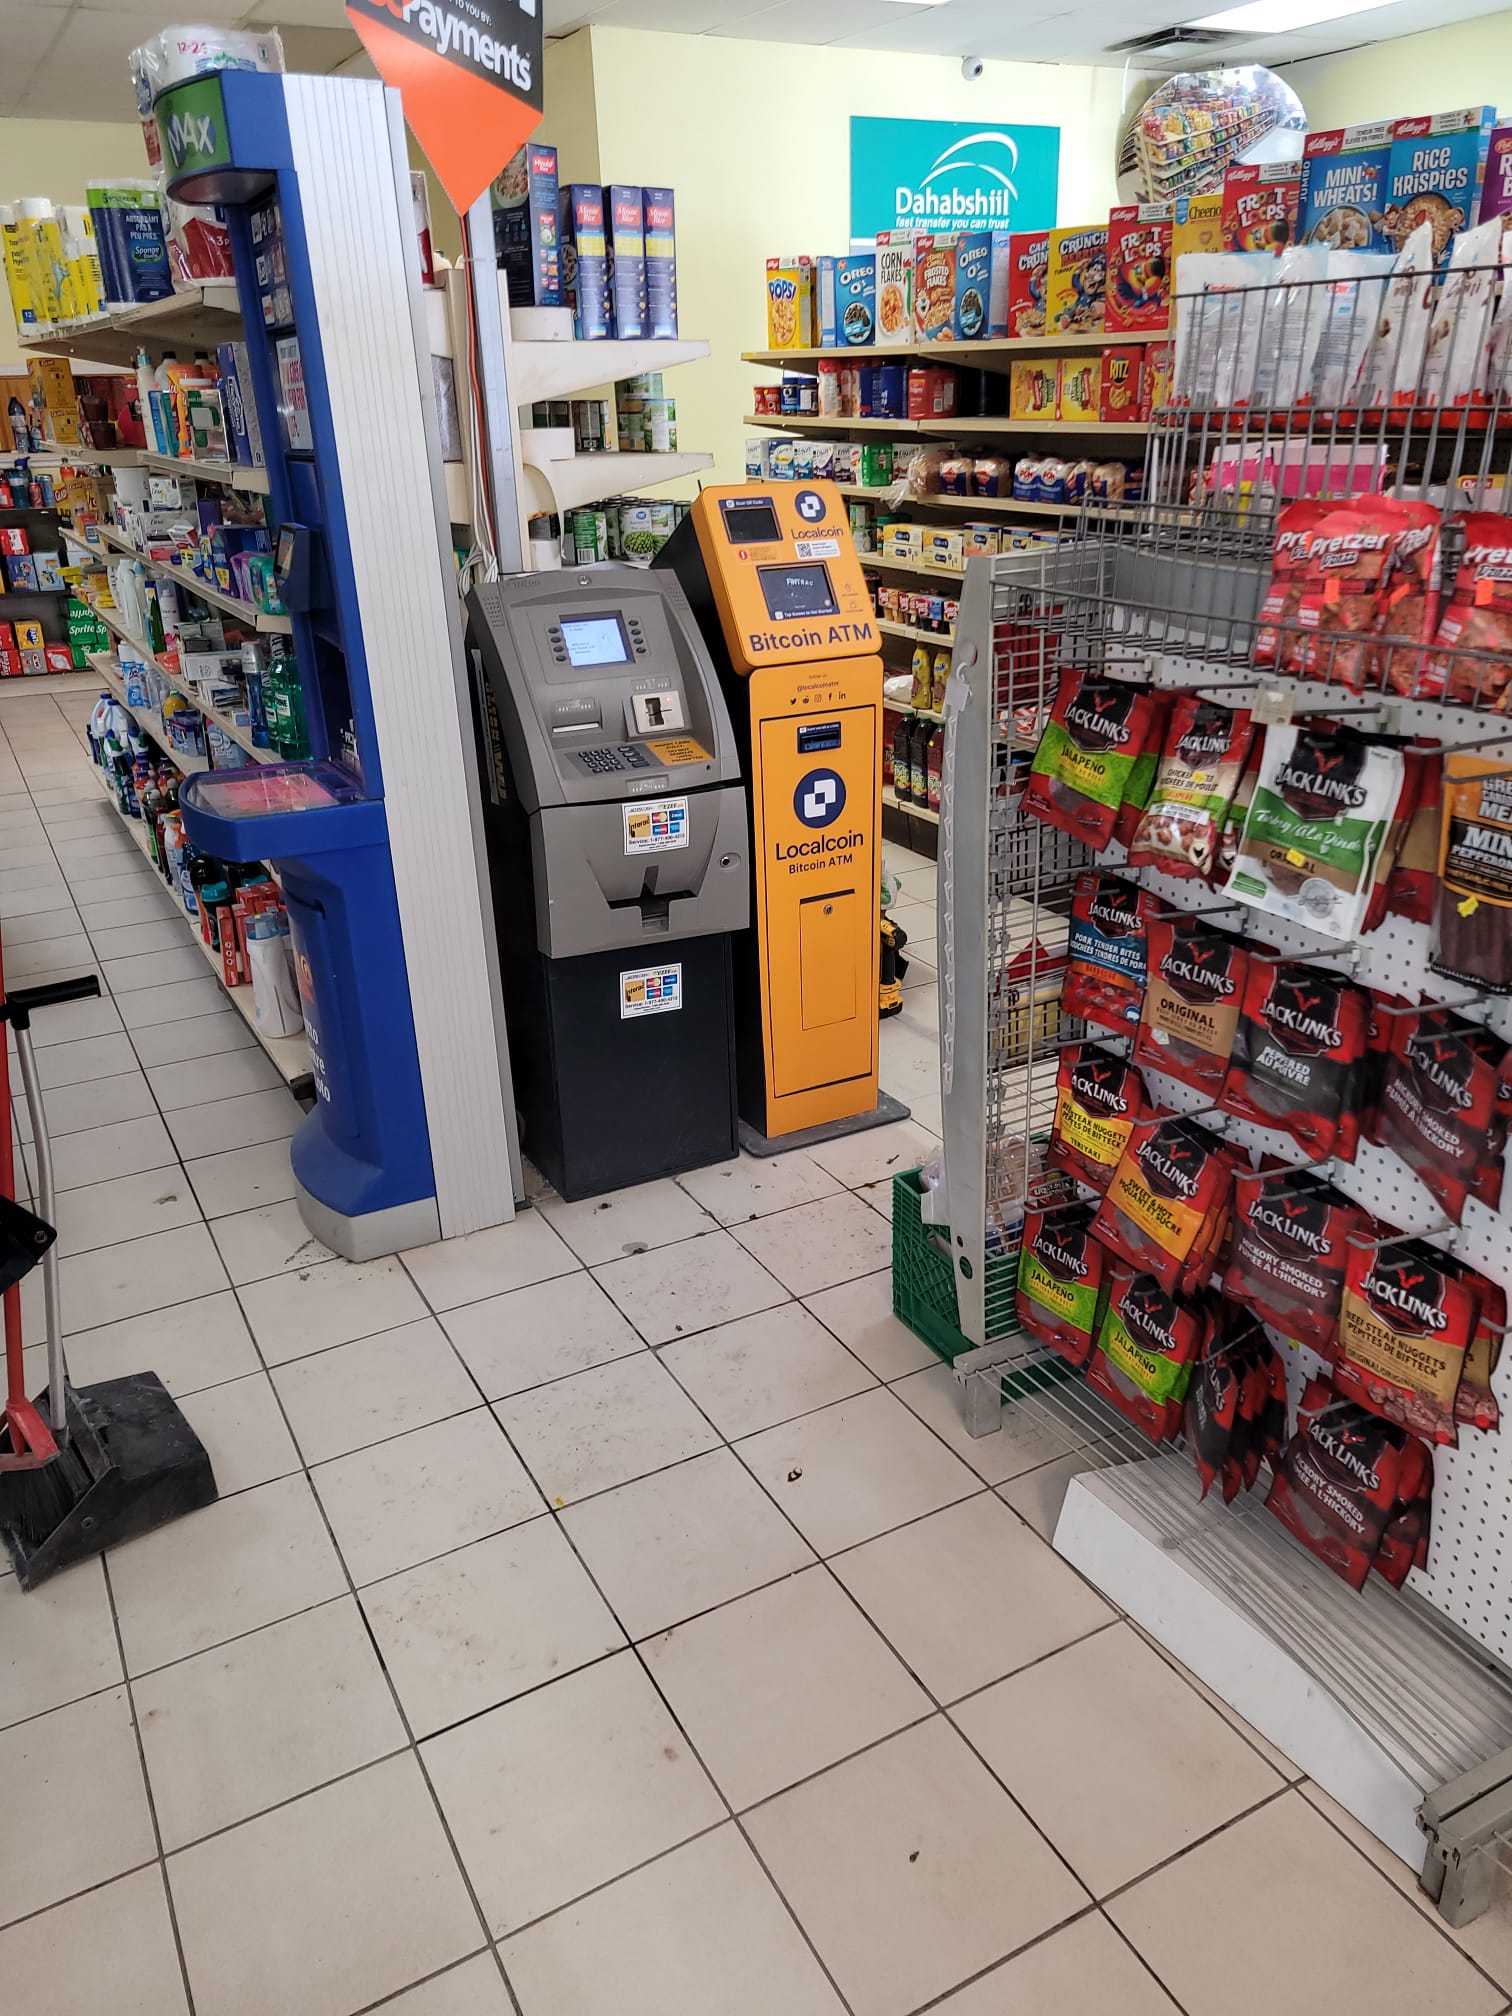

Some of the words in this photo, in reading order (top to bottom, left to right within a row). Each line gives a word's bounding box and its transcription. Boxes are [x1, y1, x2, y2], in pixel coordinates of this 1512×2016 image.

[465, 3, 480, 20] YOU
[168, 112, 214, 167] MAX
[1299, 160, 1312, 203] JUMBO
[1325, 166, 1363, 189] MINI
[895, 187, 1009, 216] Dahabshiil
[1313, 183, 1378, 209] WHEATS!
[895, 217, 913, 230] fast
[914, 217, 951, 230] transfer
[951, 218, 967, 231] you
[969, 219, 987, 230] can
[988, 218, 1009, 230] trust
[881, 252, 903, 269] CORN
[959, 246, 988, 268] OREO
[840, 265, 875, 285] OREO
[880, 269, 903, 284] FLAKES
[1110, 358, 1130, 379] RITZ
[791, 525, 844, 540] Localcoin
[69, 624, 95, 636] Sprite
[750, 628, 823, 653] Bitcoin
[828, 622, 874, 645] ATM
[1063, 703, 1094, 730] JACK
[1275, 762, 1315, 796] JACK
[776, 829, 865, 862] Localcoin
[789, 859, 826, 875] Bitcoin
[828, 854, 854, 868] ATM
[1088, 902, 1111, 921] JACK
[1074, 932, 1094, 946] PORK
[1094, 939, 1119, 955] TENDER
[1120, 947, 1141, 961] BITES
[1094, 948, 1119, 964] TENDRES
[1120, 957, 1128, 966] DE
[1159, 953, 1193, 981] JACK
[1191, 965, 1235, 995] LINK'S
[1160, 997, 1216, 1029] ORIGINAL
[1259, 998, 1298, 1029] JACK
[1294, 1012, 1343, 1047] LINK'S
[1082, 1125, 1092, 1135] DE
[1091, 1131, 1121, 1150] BIFTECK
[1092, 1121, 1128, 1143] NUGGETS
[1070, 1136, 1102, 1160] TERIYAKI
[1135, 1140, 1165, 1173] JACK
[1160, 1160, 1200, 1197] LINK'S
[1128, 1178, 1152, 1201] SWEET
[1156, 1202, 1174, 1220] HOT
[1247, 1200, 1283, 1234] JACK
[1283, 1218, 1332, 1254] LINK'S
[1031, 1234, 1058, 1260] JACK
[1055, 1247, 1089, 1276] LINK'S
[1242, 1237, 1280, 1266] HICKORY
[1279, 1260, 1324, 1289] SMOKED
[1272, 1269, 1328, 1299] L'HICKORY
[1359, 1271, 1399, 1307] JACK
[1398, 1291, 1449, 1330] LINK'S
[1117, 1294, 1143, 1327] JACK
[1139, 1314, 1177, 1351] LINK'S
[1364, 1321, 1398, 1346] STEAK
[1397, 1340, 1447, 1372] NUGGETS
[1382, 1341, 1395, 1357] DE
[1394, 1349, 1439, 1379] BIFTECK
[1307, 1416, 1342, 1458] JACK
[1335, 1447, 1381, 1490] LINK'S
[1315, 1490, 1367, 1535] L'HICKORY
[1325, 1483, 1365, 1523] SMOKED
